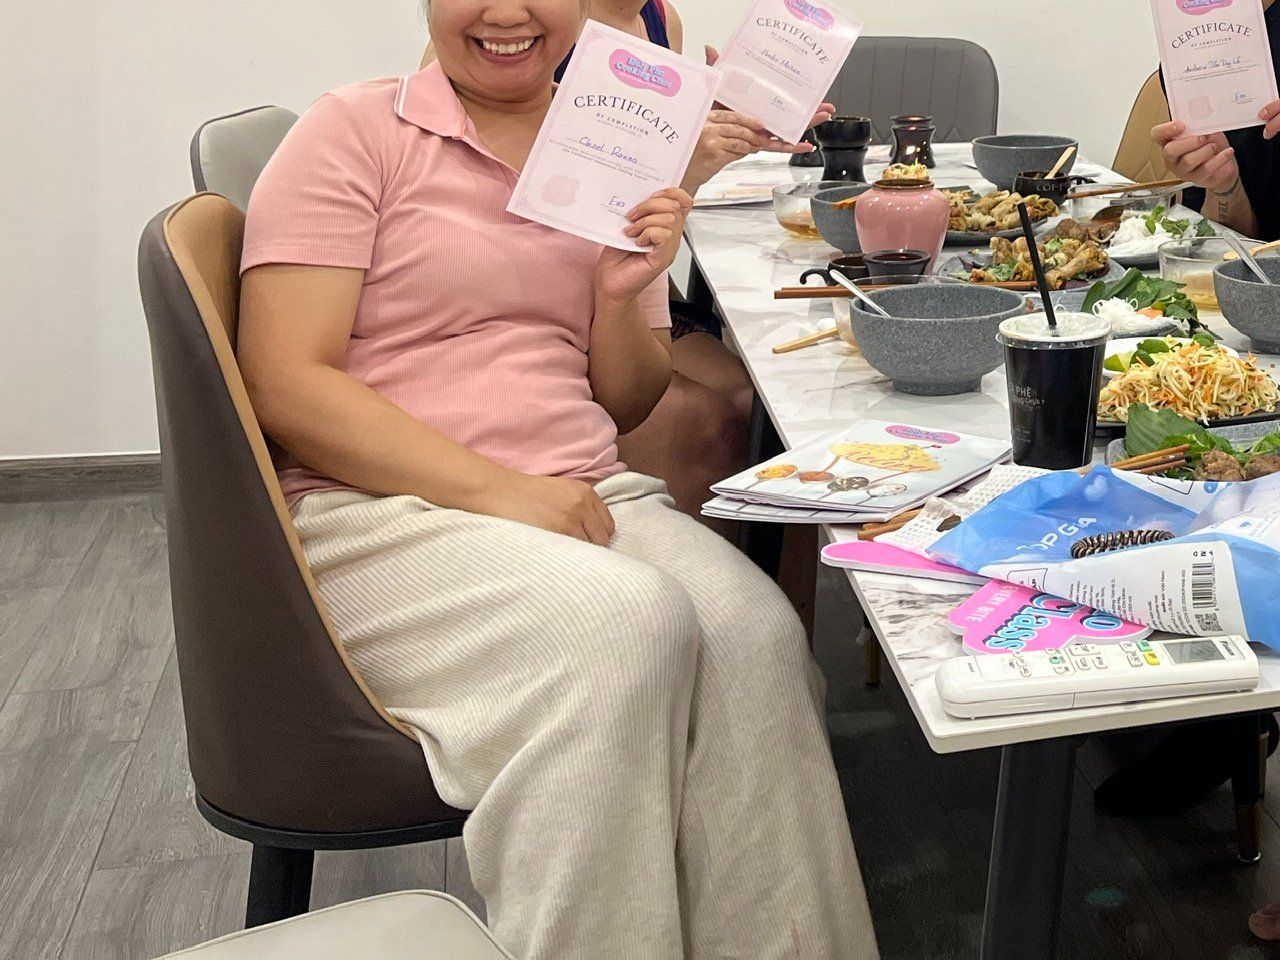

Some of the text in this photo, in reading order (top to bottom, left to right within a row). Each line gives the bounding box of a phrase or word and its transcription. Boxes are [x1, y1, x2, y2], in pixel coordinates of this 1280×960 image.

[756, 17, 829, 65] CERTIFICATE
[1171, 22, 1253, 50] CERTIFICATE
[574, 94, 679, 145] CERTIFICATE
[965, 602, 989, 623] BITE
[983, 593, 1084, 652] Class
